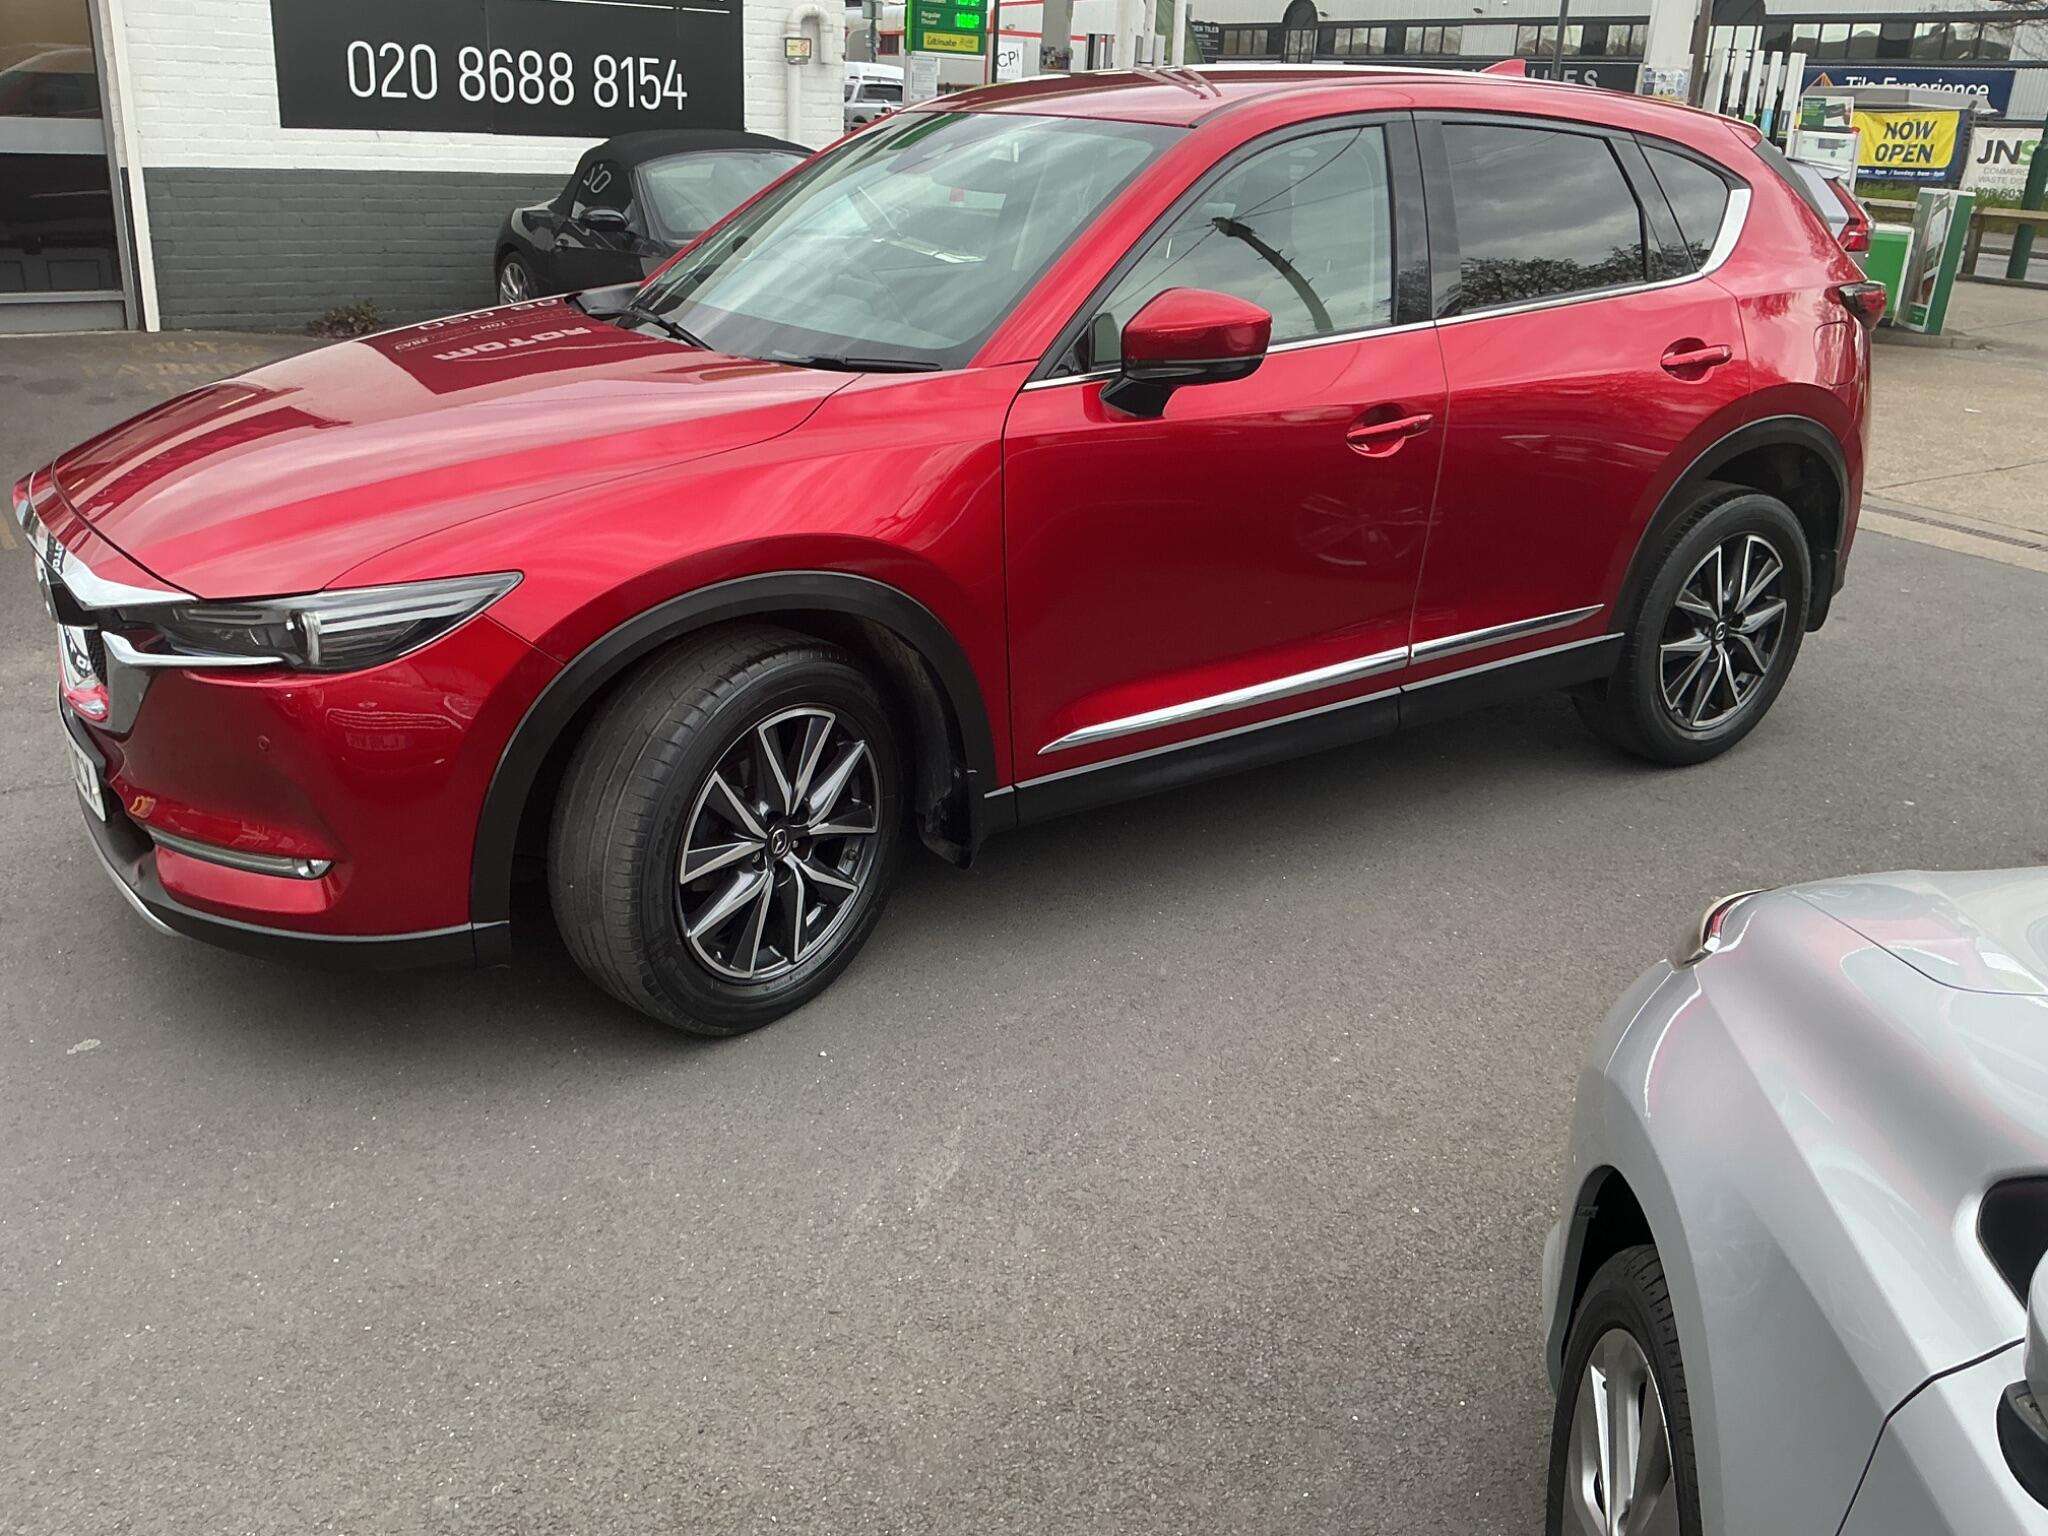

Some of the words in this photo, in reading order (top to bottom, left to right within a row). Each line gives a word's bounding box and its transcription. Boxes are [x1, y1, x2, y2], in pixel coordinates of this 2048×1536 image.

[346, 40, 438, 100] 020
[457, 46, 575, 106] 8688
[593, 54, 688, 111] 8154
[1883, 119, 1938, 141] NOW
[1874, 142, 1935, 164] OPEN
